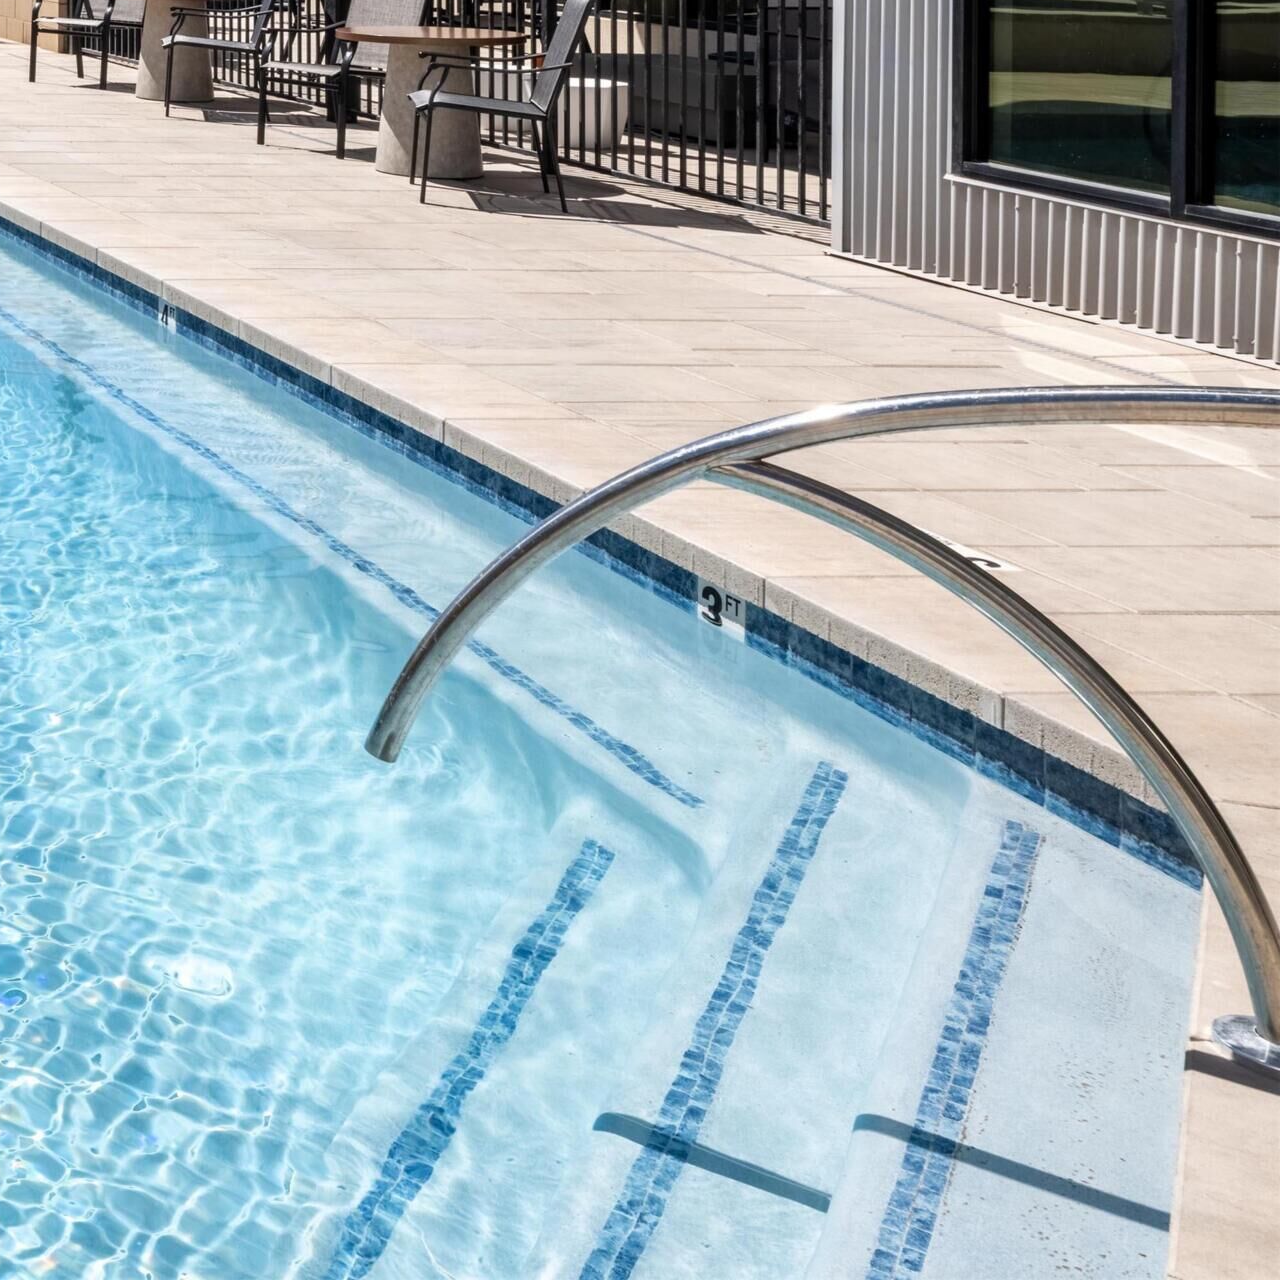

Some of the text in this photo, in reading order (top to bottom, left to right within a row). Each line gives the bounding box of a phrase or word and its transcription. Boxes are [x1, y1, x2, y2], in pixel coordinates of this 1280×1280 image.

[169, 306, 175, 318] FT
[702, 586, 741, 627] 3 FT
